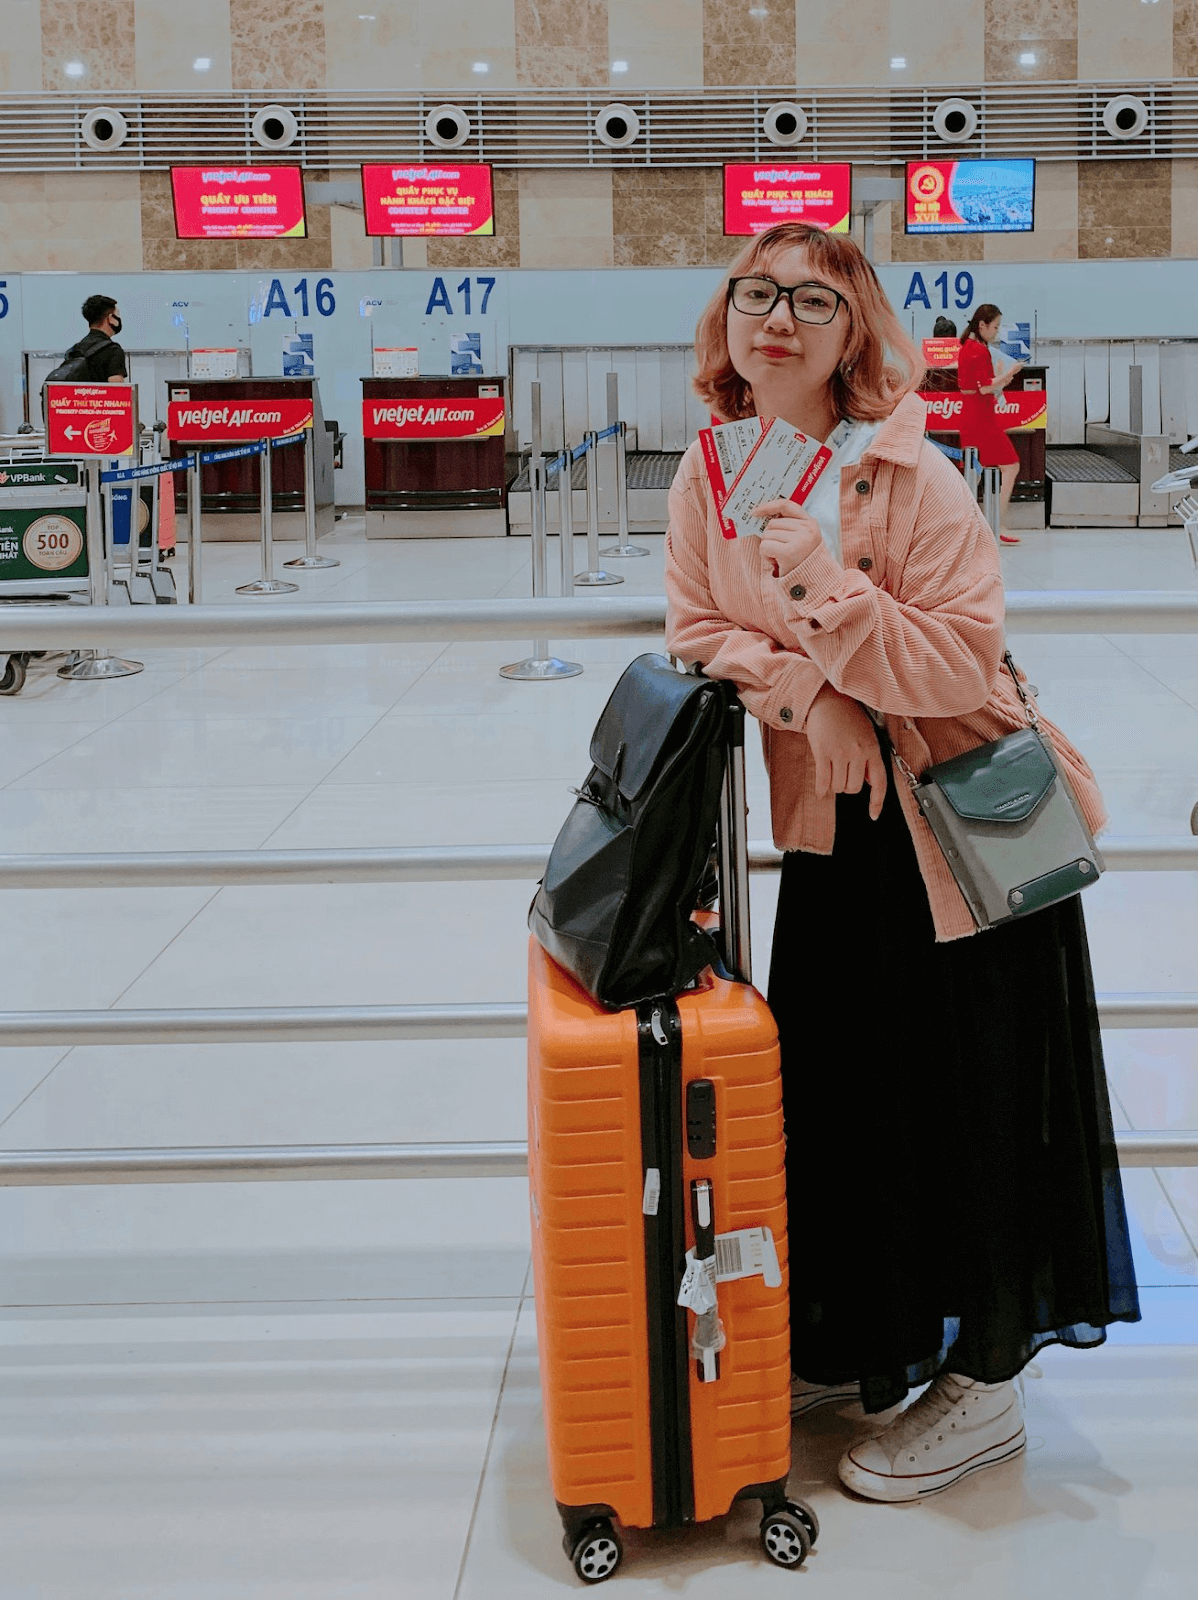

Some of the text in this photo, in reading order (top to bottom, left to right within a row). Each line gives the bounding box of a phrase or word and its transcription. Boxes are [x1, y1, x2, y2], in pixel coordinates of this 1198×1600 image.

[263, 278, 336, 317] A16
[425, 277, 496, 315] A17
[903, 271, 974, 310] A19
[10, 473, 46, 483] VPBank
[37, 534, 69, 550] 500
